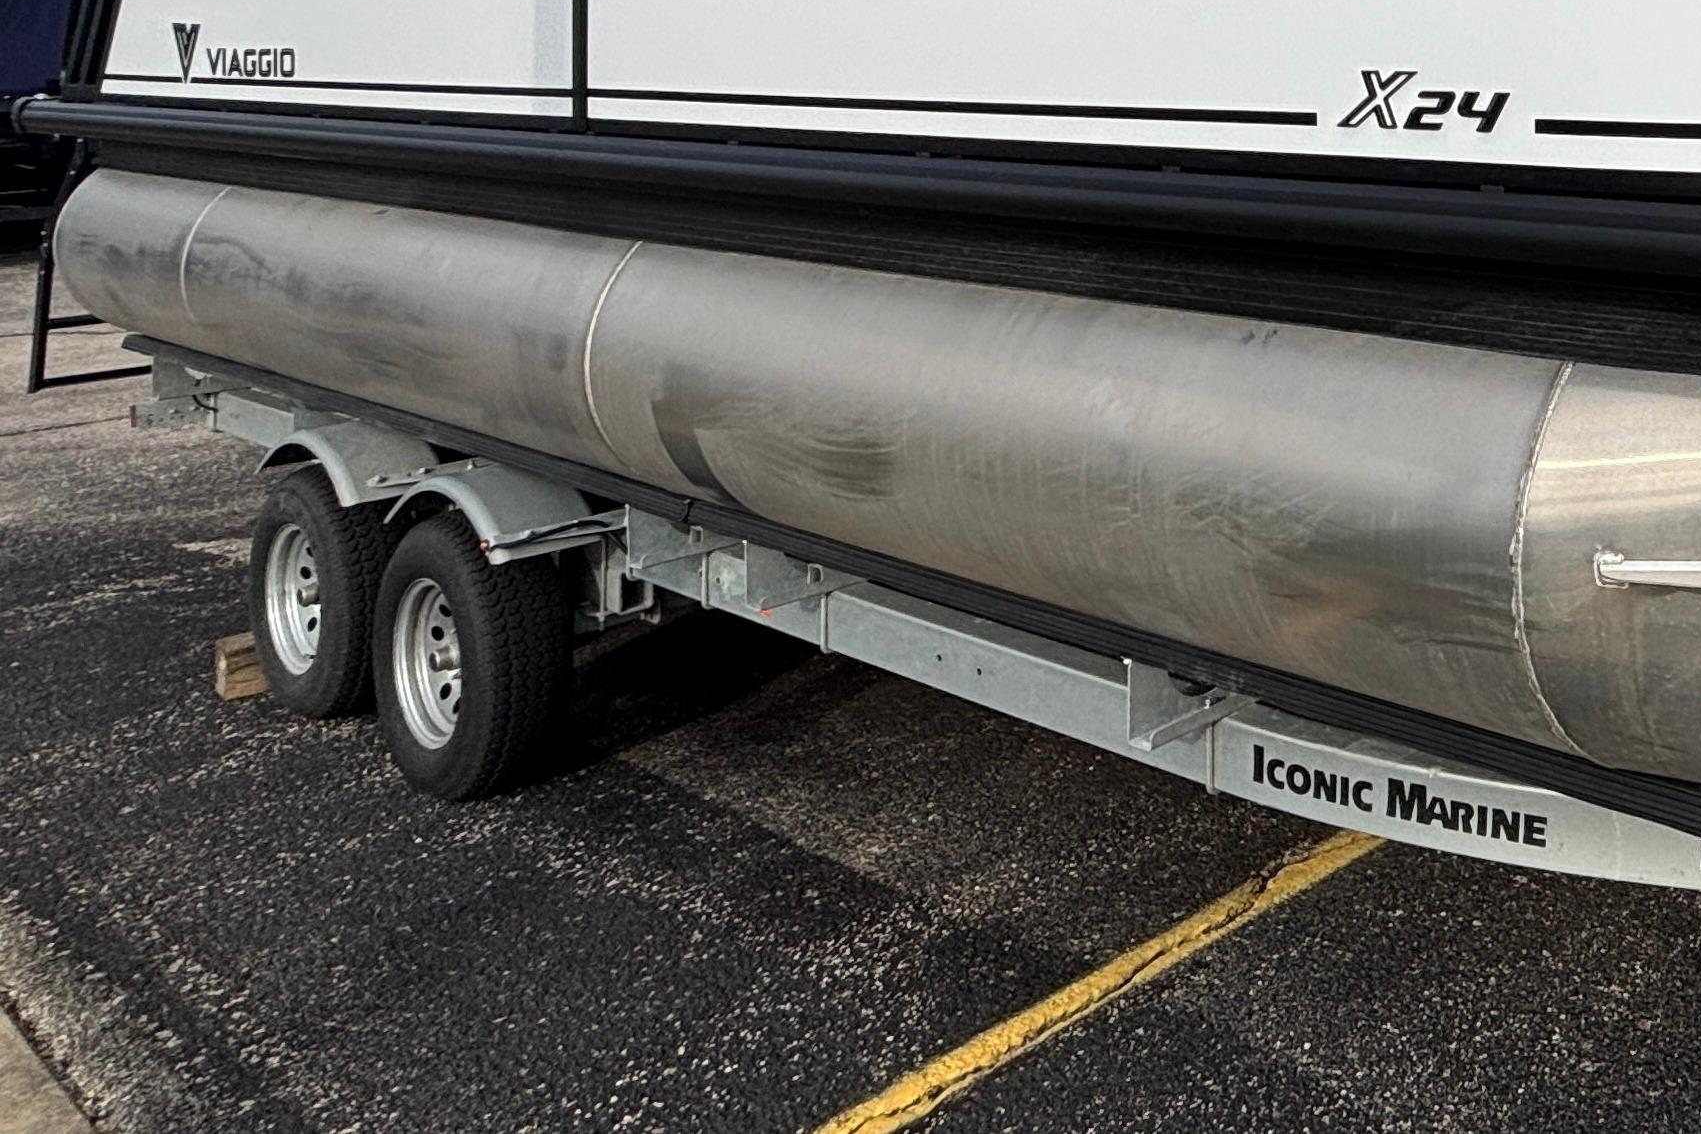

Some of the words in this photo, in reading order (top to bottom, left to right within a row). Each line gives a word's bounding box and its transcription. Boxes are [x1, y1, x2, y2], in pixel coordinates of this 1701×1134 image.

[206, 47, 295, 78] VIAGGIO
[1337, 70, 1510, 133] X24
[1252, 744, 1374, 813] ICONIC
[1386, 777, 1548, 848] MARINE
